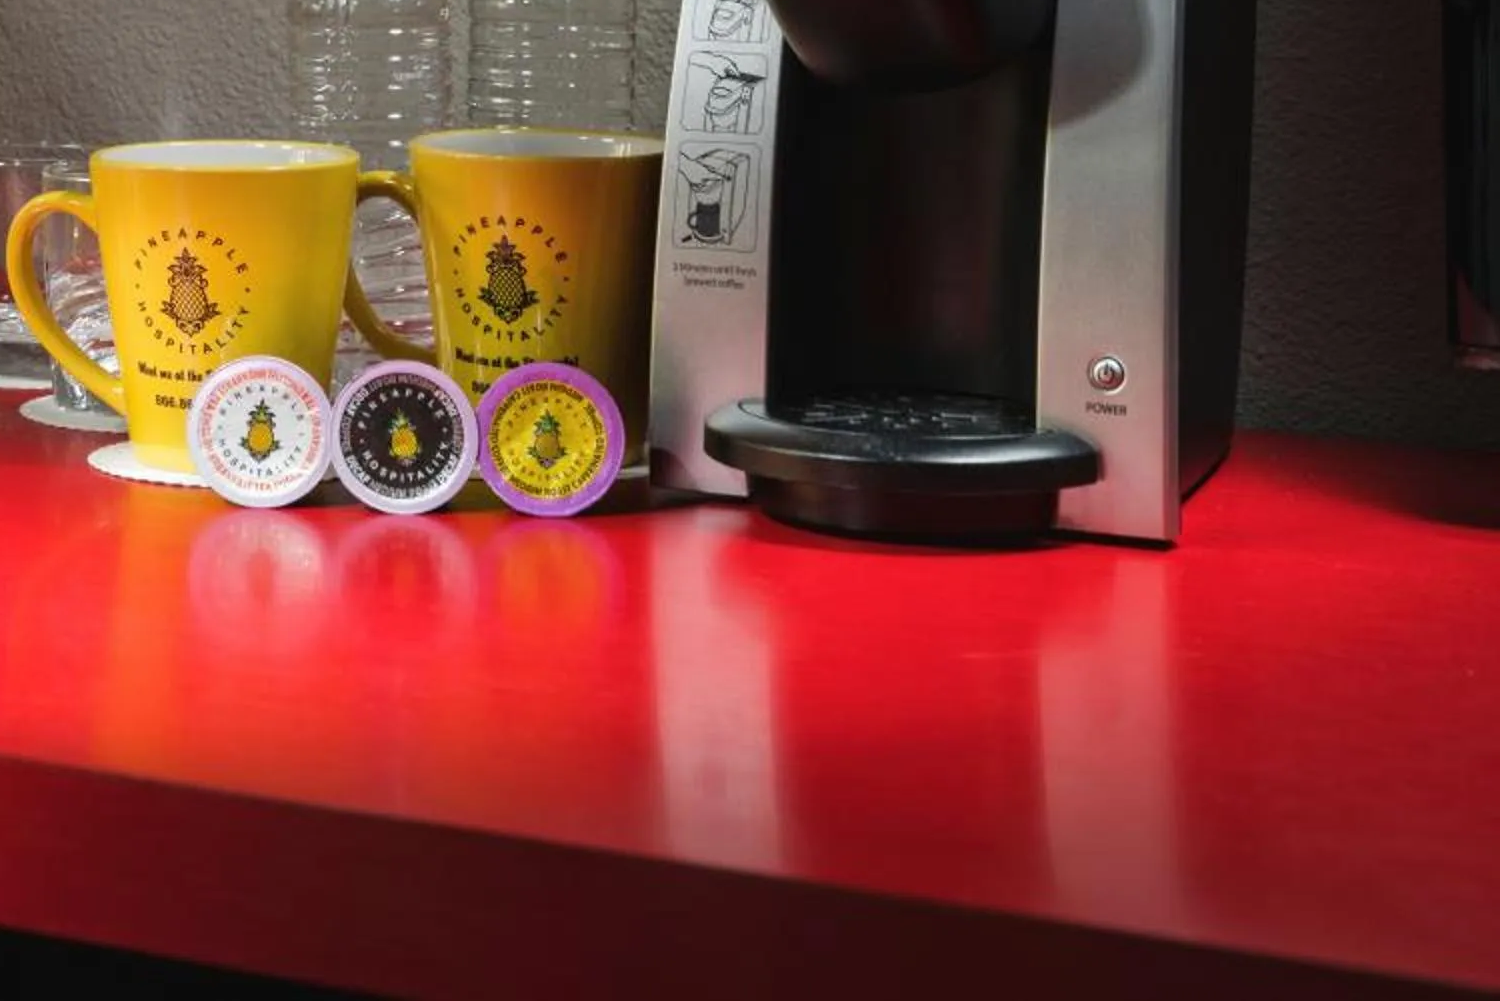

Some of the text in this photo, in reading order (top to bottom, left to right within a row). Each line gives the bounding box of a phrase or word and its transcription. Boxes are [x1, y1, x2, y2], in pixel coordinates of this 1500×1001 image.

[135, 228, 249, 275] PINEAPPLE
[453, 214, 567, 263] PINEAPPLE
[137, 301, 250, 355] HOSPITALITY
[456, 287, 569, 342] HOSPITALITY
[357, 388, 445, 431] PINEAPPLE
[1085, 401, 1127, 416] POWER
[362, 442, 449, 483] HOSPITALITY
